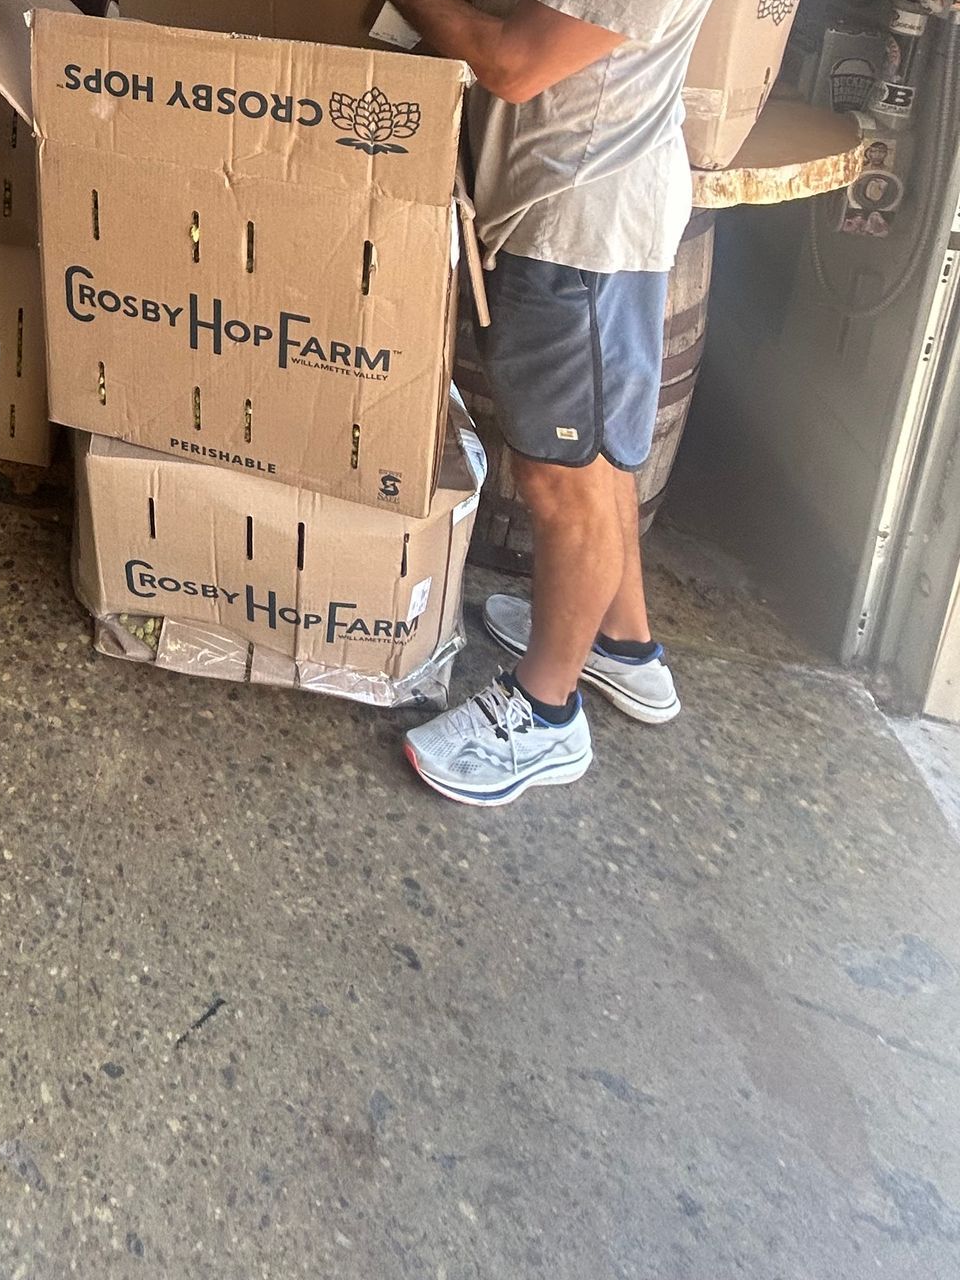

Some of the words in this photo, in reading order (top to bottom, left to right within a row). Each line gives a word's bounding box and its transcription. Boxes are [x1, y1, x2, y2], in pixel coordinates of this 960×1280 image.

[63, 63, 154, 102] HOPS
[166, 80, 323, 127] CROSBY
[64, 266, 184, 327] CROSBY
[188, 292, 273, 355] HOP
[278, 311, 390, 372] FARM
[290, 356, 352, 376] WILLAMETTE
[353, 370, 389, 381] VALLEY
[170, 437, 277, 474] PERISHABLE
[125, 559, 239, 605] CROSBY
[245, 584, 322, 630] HOP
[326, 602, 419, 643] FARM
[337, 634, 392, 644] WILLAMETTE
